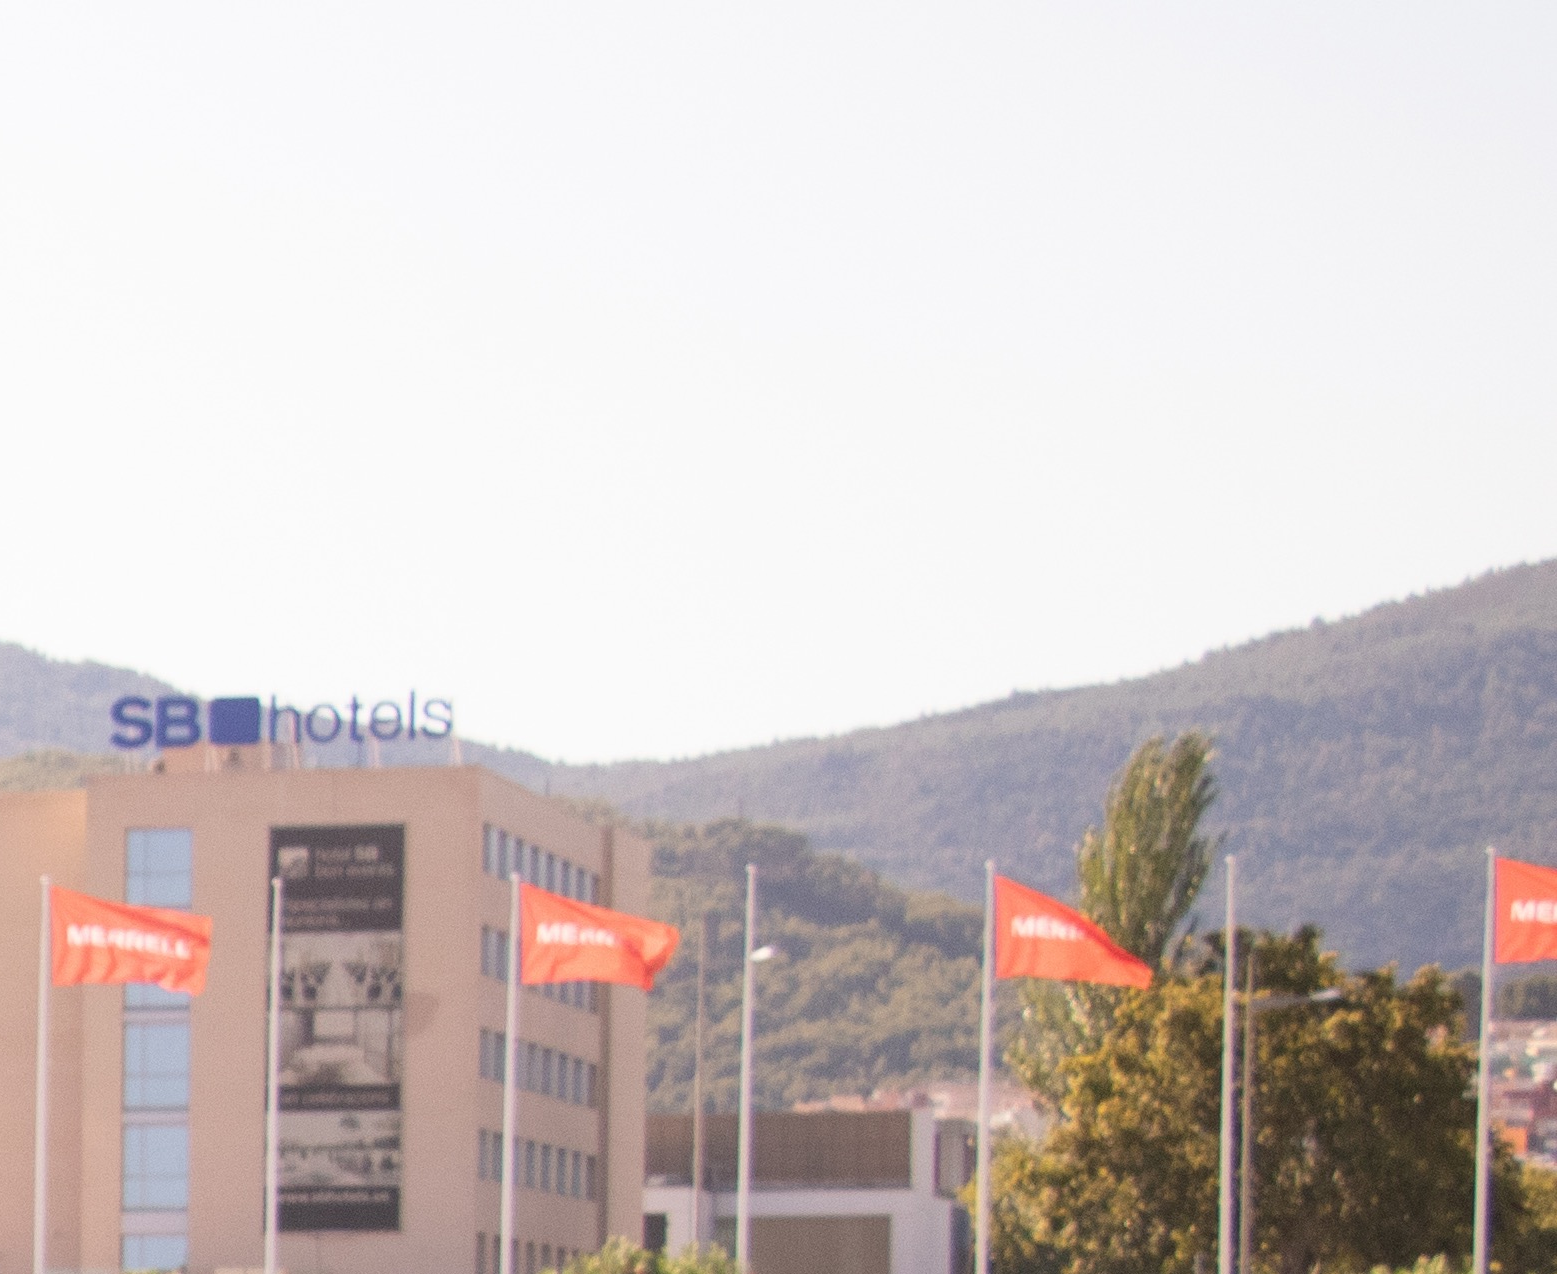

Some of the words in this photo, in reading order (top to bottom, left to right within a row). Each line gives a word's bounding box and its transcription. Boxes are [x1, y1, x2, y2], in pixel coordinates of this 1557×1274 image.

[110, 695, 201, 749] SB
[269, 690, 453, 744] hotels
[67, 924, 190, 960] MERRELL
